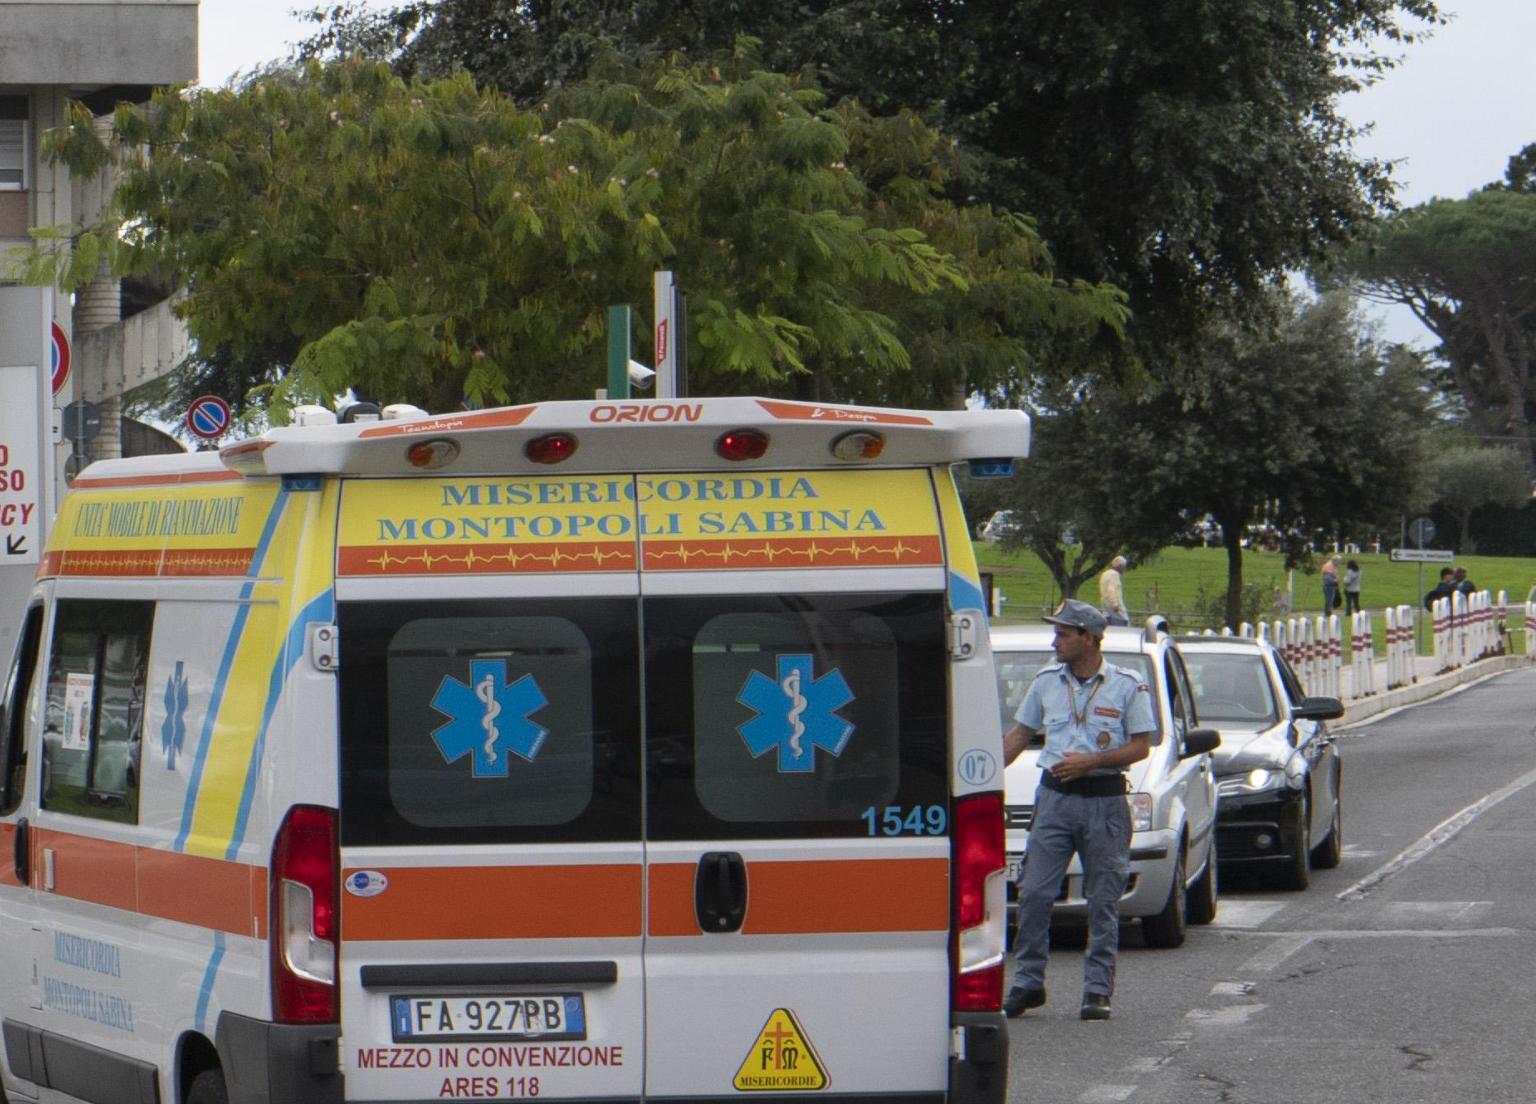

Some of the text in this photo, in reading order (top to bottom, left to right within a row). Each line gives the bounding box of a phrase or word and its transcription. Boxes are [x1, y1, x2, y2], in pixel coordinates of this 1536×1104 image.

[590, 404, 703, 423] ORION
[440, 477, 819, 506] MISERICORDIA
[108, 501, 149, 537] MOBILE
[377, 509, 886, 541] MONTOPOLI SABINA
[965, 754, 987, 780] 07
[861, 805, 947, 836] 1549
[53, 930, 121, 978] MISERICORDIA
[416, 1000, 454, 1032] FA
[358, 1046, 623, 1069] MEZZO IN CONVENZIONE
[439, 1077, 539, 1097] ARES 118
[740, 1076, 817, 1087] MISERICORDIE
